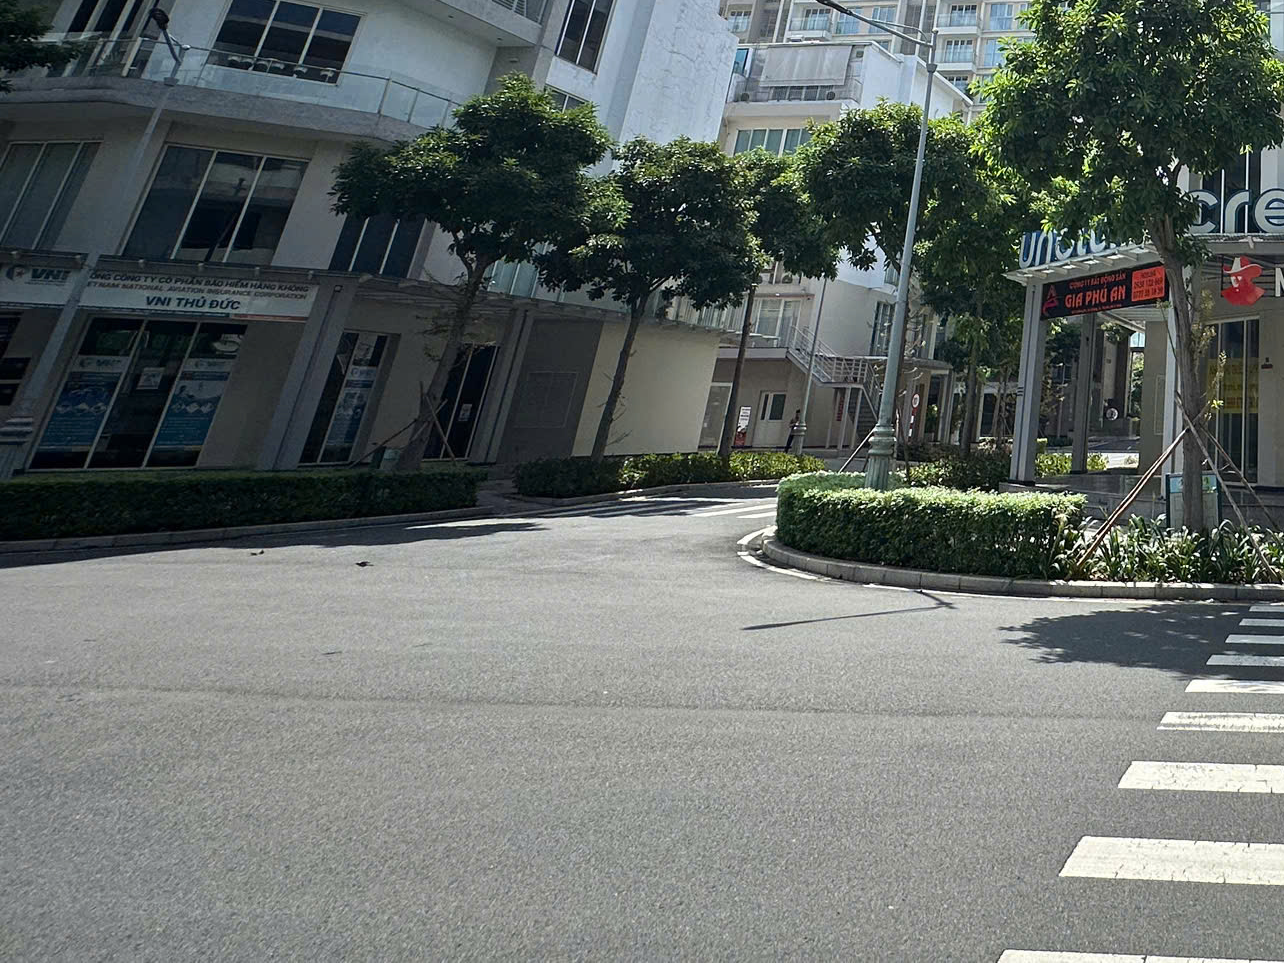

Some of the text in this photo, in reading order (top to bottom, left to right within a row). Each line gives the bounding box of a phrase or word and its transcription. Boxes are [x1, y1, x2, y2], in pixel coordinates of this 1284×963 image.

[143, 275, 157, 283] TY
[145, 295, 241, 310] VNI THỦ ĐỨC
[1065, 292, 1084, 309] GIA
[1085, 285, 1108, 306] PHÚ
[1110, 284, 1126, 303] AN
